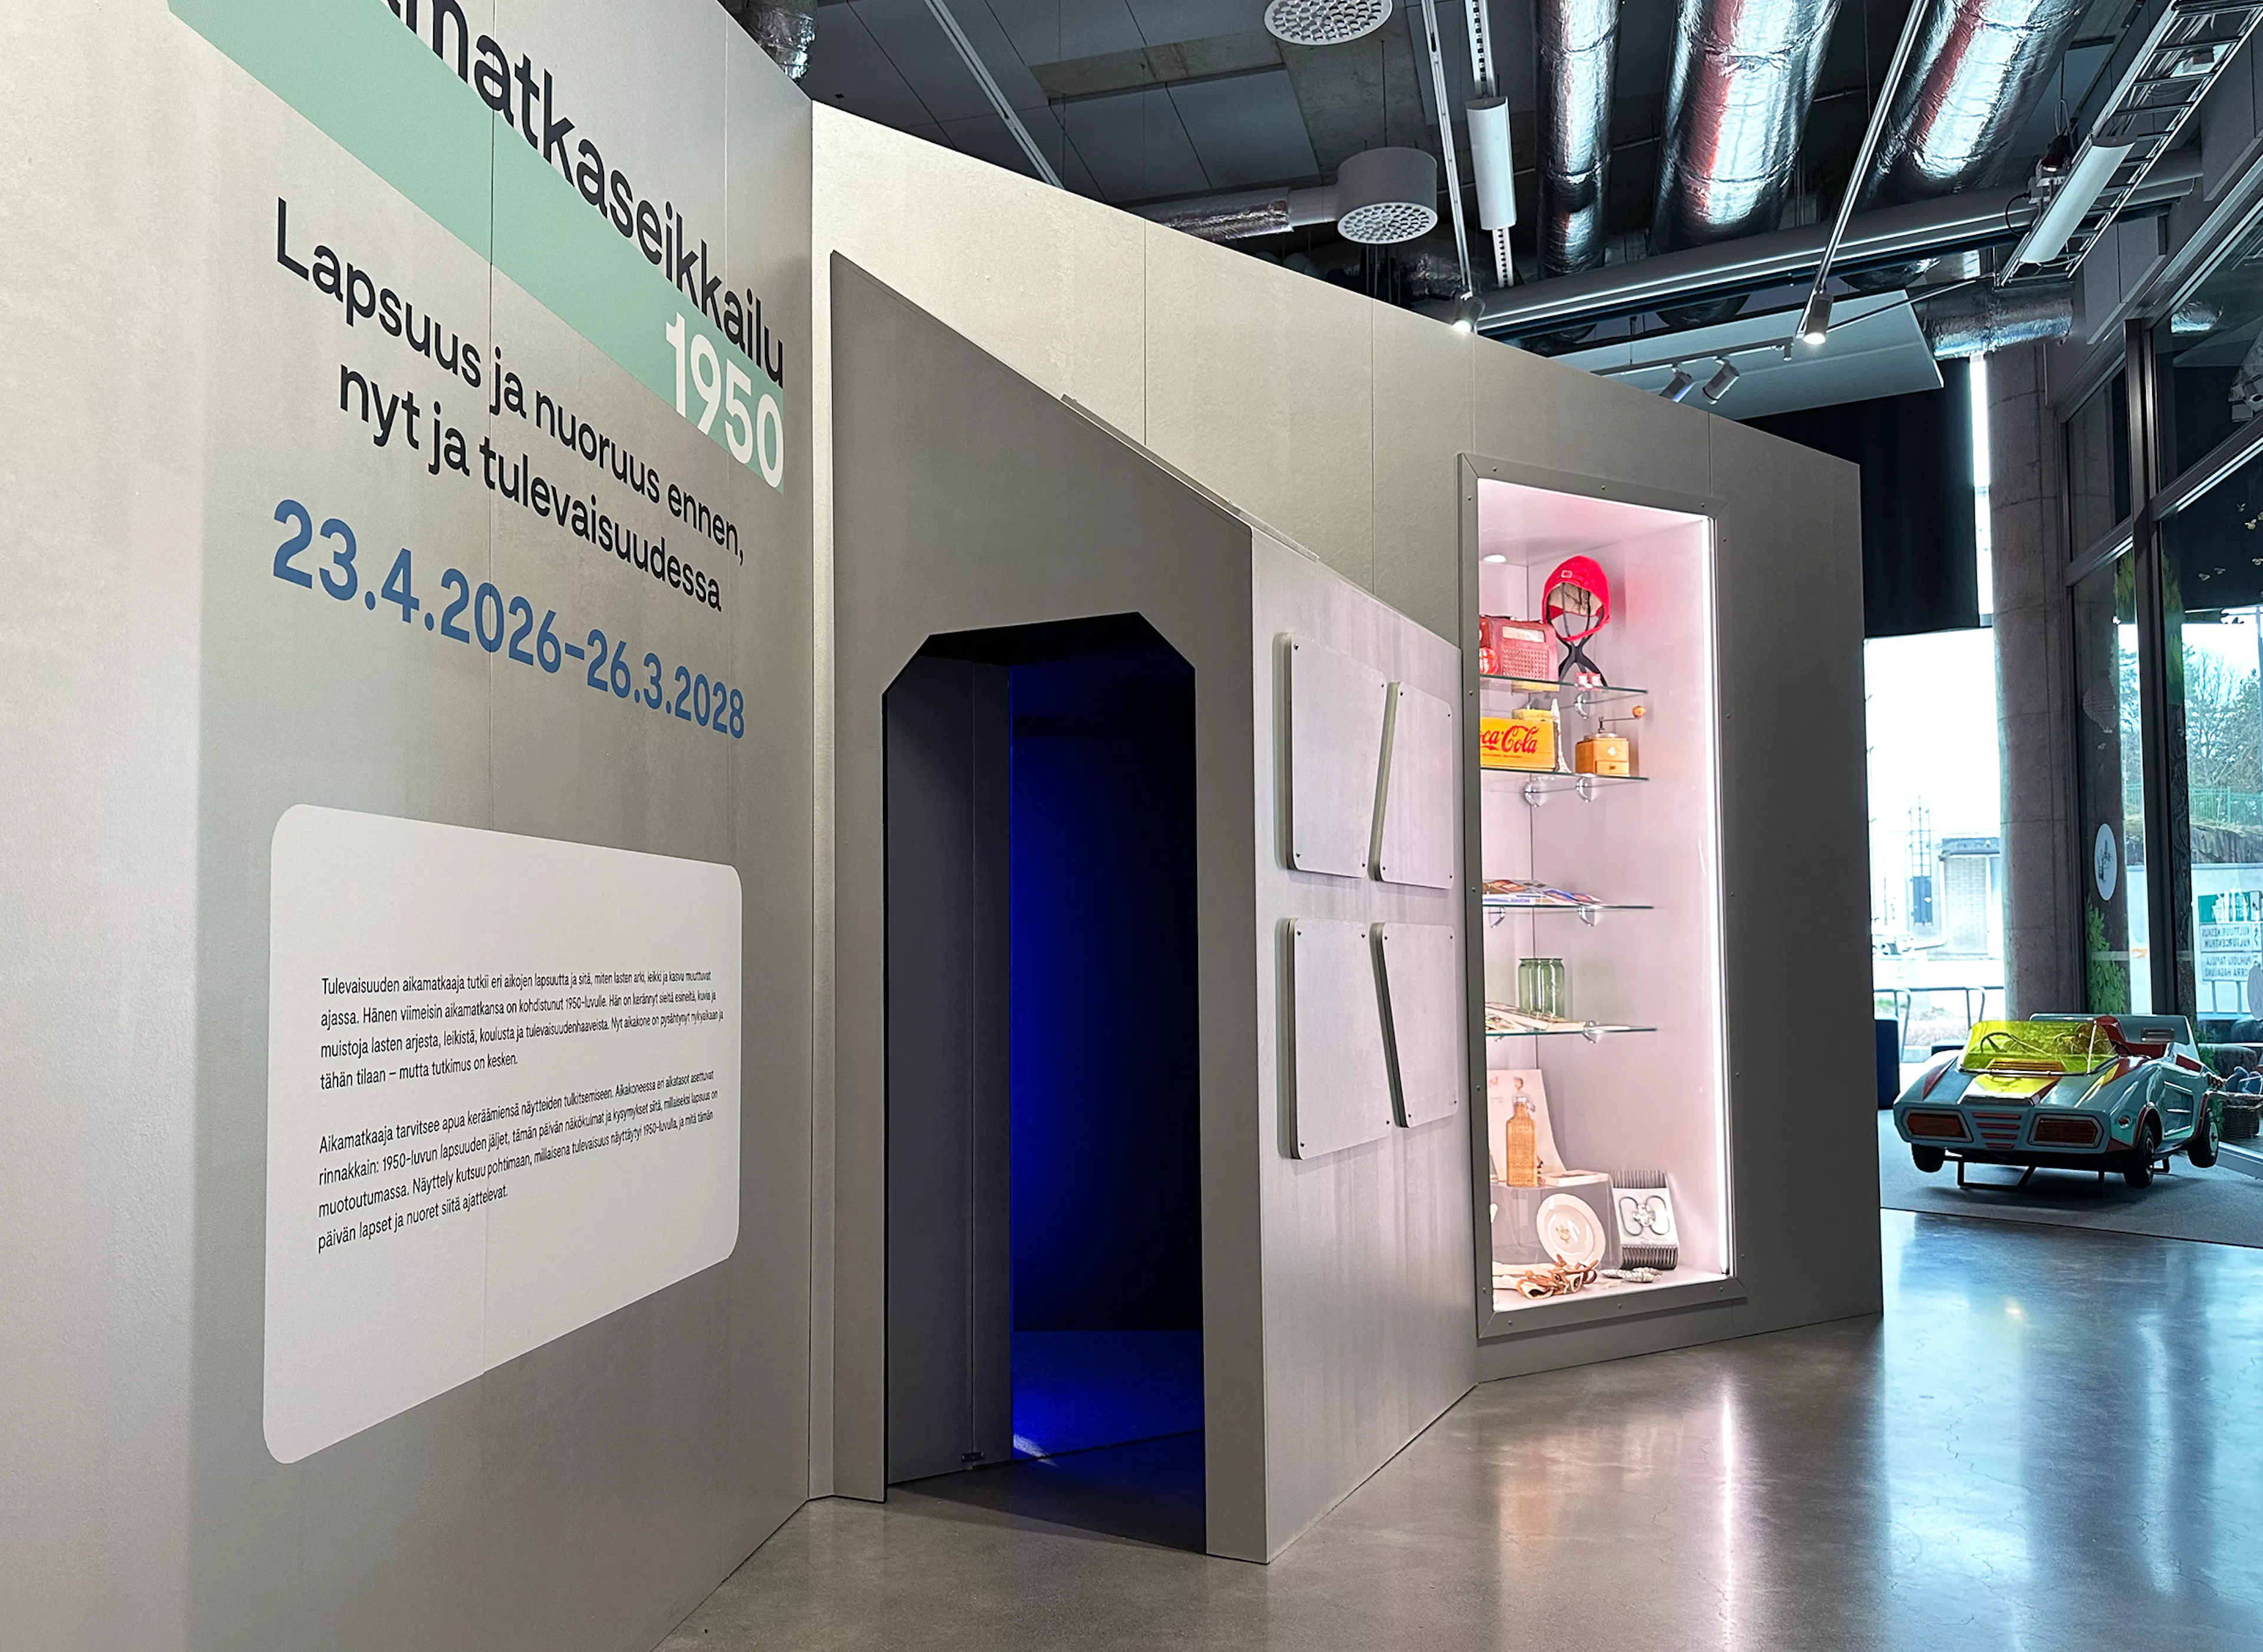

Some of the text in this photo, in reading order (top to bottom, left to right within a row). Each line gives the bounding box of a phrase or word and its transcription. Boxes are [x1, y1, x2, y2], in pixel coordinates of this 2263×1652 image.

[388, 0, 784, 388] matkaseikkailu
[276, 197, 744, 566] Lapsuus ja nuoruus ennen,
[665, 312, 784, 488] 1950
[339, 364, 722, 612] nyt ja tulevaisuudessa
[1480, 726, 1539, 754] ca-Cola
[321, 1010, 359, 1031] ajassa.
[363, 1007, 397, 1023] Hänen
[400, 1004, 442, 1021] viimeisin
[445, 1001, 504, 1018] aikamatkansa
[506, 1003, 517, 1014] on
[519, 998, 563, 1013] kohdistunut
[566, 995, 607, 1009] 1950-luvulle.
[609, 994, 622, 1007] Hän
[624, 997, 631, 1006] on
[711, 992, 716, 1003] ja
[322, 976, 400, 995] Tulevaisuuden
[403, 975, 465, 994] aikamatkaaja
[467, 974, 489, 989] tutkii
[491, 974, 502, 988] eri
[504, 974, 532, 991] aikojen
[535, 973, 569, 990] lapsuutta
[570, 972, 577, 989] ja
[579, 972, 592, 986] sitä,
[595, 972, 612, 984] miten
[614, 971, 632, 984] lasten
[662, 971, 668, 985] ja
[321, 1038, 368, 1059] muistoja
[372, 1037, 403, 1053] lasten
[405, 1033, 441, 1053] arjesta,
[444, 1030, 477, 1046] leikistä,
[480, 1026, 515, 1042] koulusta
[516, 1025, 524, 1043] ja
[526, 1018, 609, 1037] tulevaisuudenhaaveista.
[611, 1017, 623, 1033] Nyt
[624, 1015, 651, 1028] aikakone
[652, 1017, 659, 1026] on
[718, 1009, 723, 1023] ja
[320, 1071, 352, 1090] tähän
[357, 1068, 385, 1085] tilaan
[400, 1063, 429, 1080] mutta
[431, 1058, 471, 1075] tutkimus
[474, 1058, 485, 1070] on
[487, 1052, 517, 1068] kesken.
[319, 1126, 393, 1153] Aikamatkaaja
[396, 1120, 440, 1139] tarvitsee
[443, 1116, 466, 1133] apua
[468, 1103, 520, 1125] keräämiensä
[522, 1096, 562, 1117] näytteiden
[564, 1089, 613, 1107] tulkitsemiseen.
[319, 1159, 379, 1185] rinnakkain:
[382, 1149, 437, 1171] 1950-luvun
[440, 1136, 486, 1161] lapsuuden
[487, 1132, 510, 1152] jäljet,
[512, 1126, 537, 1142] tämän
[539, 1120, 563, 1140] päivän
[565, 1112, 604, 1131] näkökulmat
[605, 1110, 612, 1126] ja
[613, 1103, 648, 1123] kysymykset
[711, 1090, 718, 1099] on
[319, 1185, 409, 1218] muotoutumassa.
[413, 1170, 454, 1195] Näyttely
[456, 1166, 486, 1183] kutsuu
[487, 1155, 532, 1179] pohtimaan,
[572, 1136, 609, 1154] tulevaisuus
[679, 1116, 684, 1130] ja
[698, 1110, 713, 1122] tämän
[319, 1184, 508, 1254] päivän lapset ja nuoret siitä ajattelevat.
